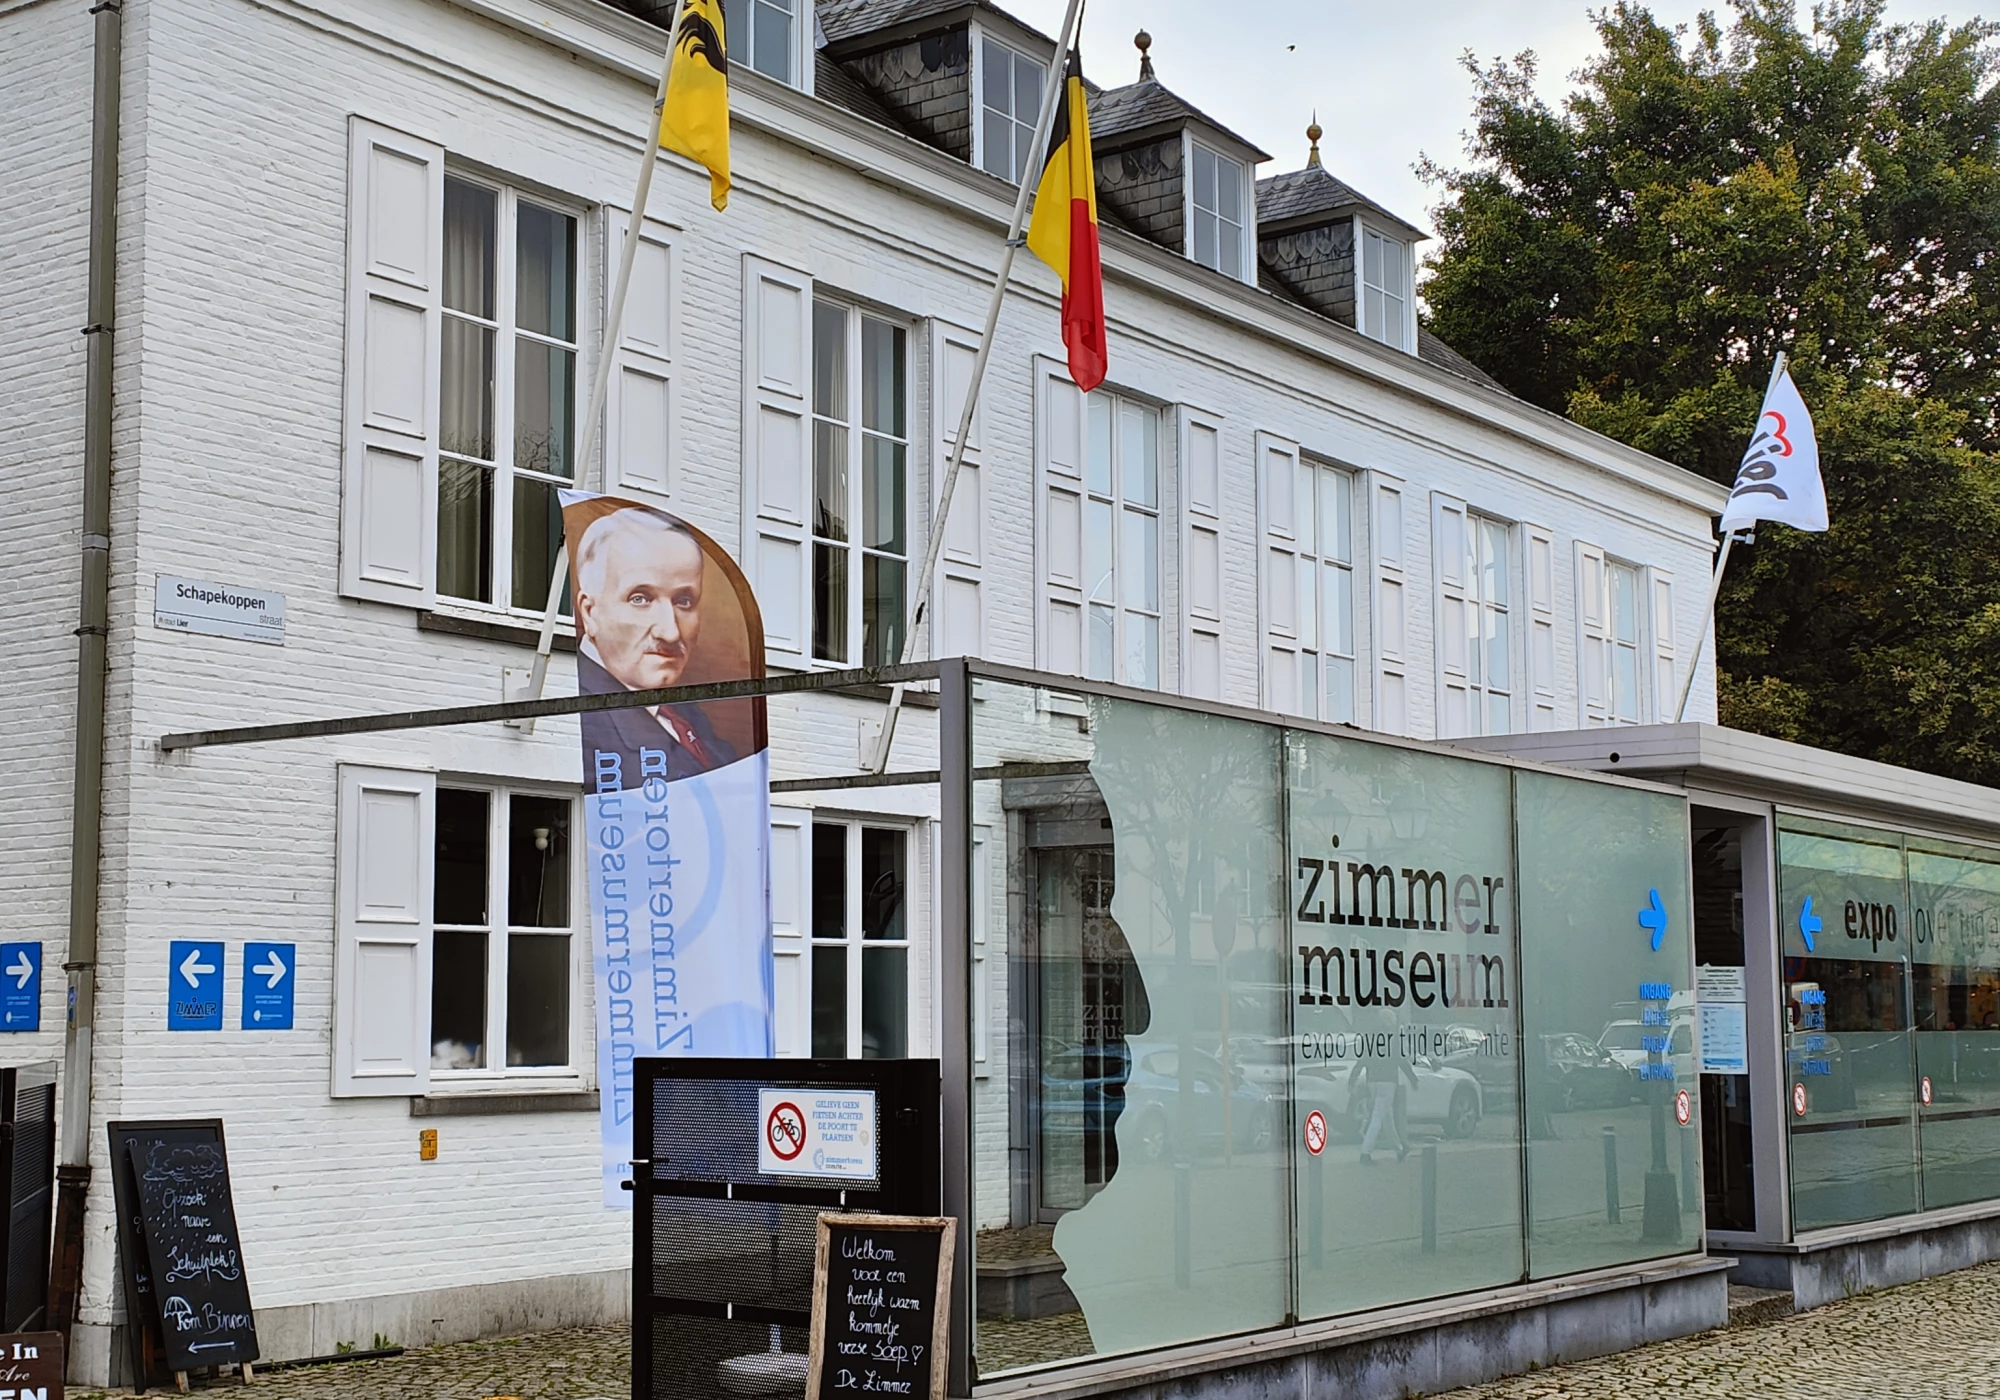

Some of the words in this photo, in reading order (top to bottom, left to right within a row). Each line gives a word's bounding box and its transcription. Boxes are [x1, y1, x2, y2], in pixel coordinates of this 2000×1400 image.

[176, 583, 266, 610] Schapekoppen
[259, 614, 283, 627] straat
[1297, 834, 1504, 934] zimmer
[1844, 899, 1897, 953] expo
[1298, 945, 1509, 1008] museum
[1640, 983, 1671, 1000] INGANG
[1802, 990, 1826, 1005] INGANG
[1301, 1031, 1347, 1068] expo
[1353, 1031, 1394, 1058] over
[1399, 1025, 1427, 1065] tijd
[842, 1101, 860, 1109] GEEN
[812, 1112, 836, 1120] FIETSEN
[838, 1112, 863, 1120] ACHTER
[822, 1134, 853, 1142] PLAATSEN
[181, 1215, 212, 1228] naar
[205, 1233, 228, 1244] een
[842, 1236, 896, 1261] Welkom
[852, 1269, 881, 1282] voor
[886, 1271, 906, 1283] een
[847, 1285, 885, 1317] heerlijk
[890, 1296, 920, 1310] warm
[201, 1302, 254, 1335] Binnen
[849, 1311, 899, 1344] kommetje
[12, 1343, 38, 1360] In
[838, 1341, 868, 1355] verse
[0, 1364, 30, 1382] Are
[834, 1369, 858, 1388] De
[862, 1369, 911, 1393] Zimmer
